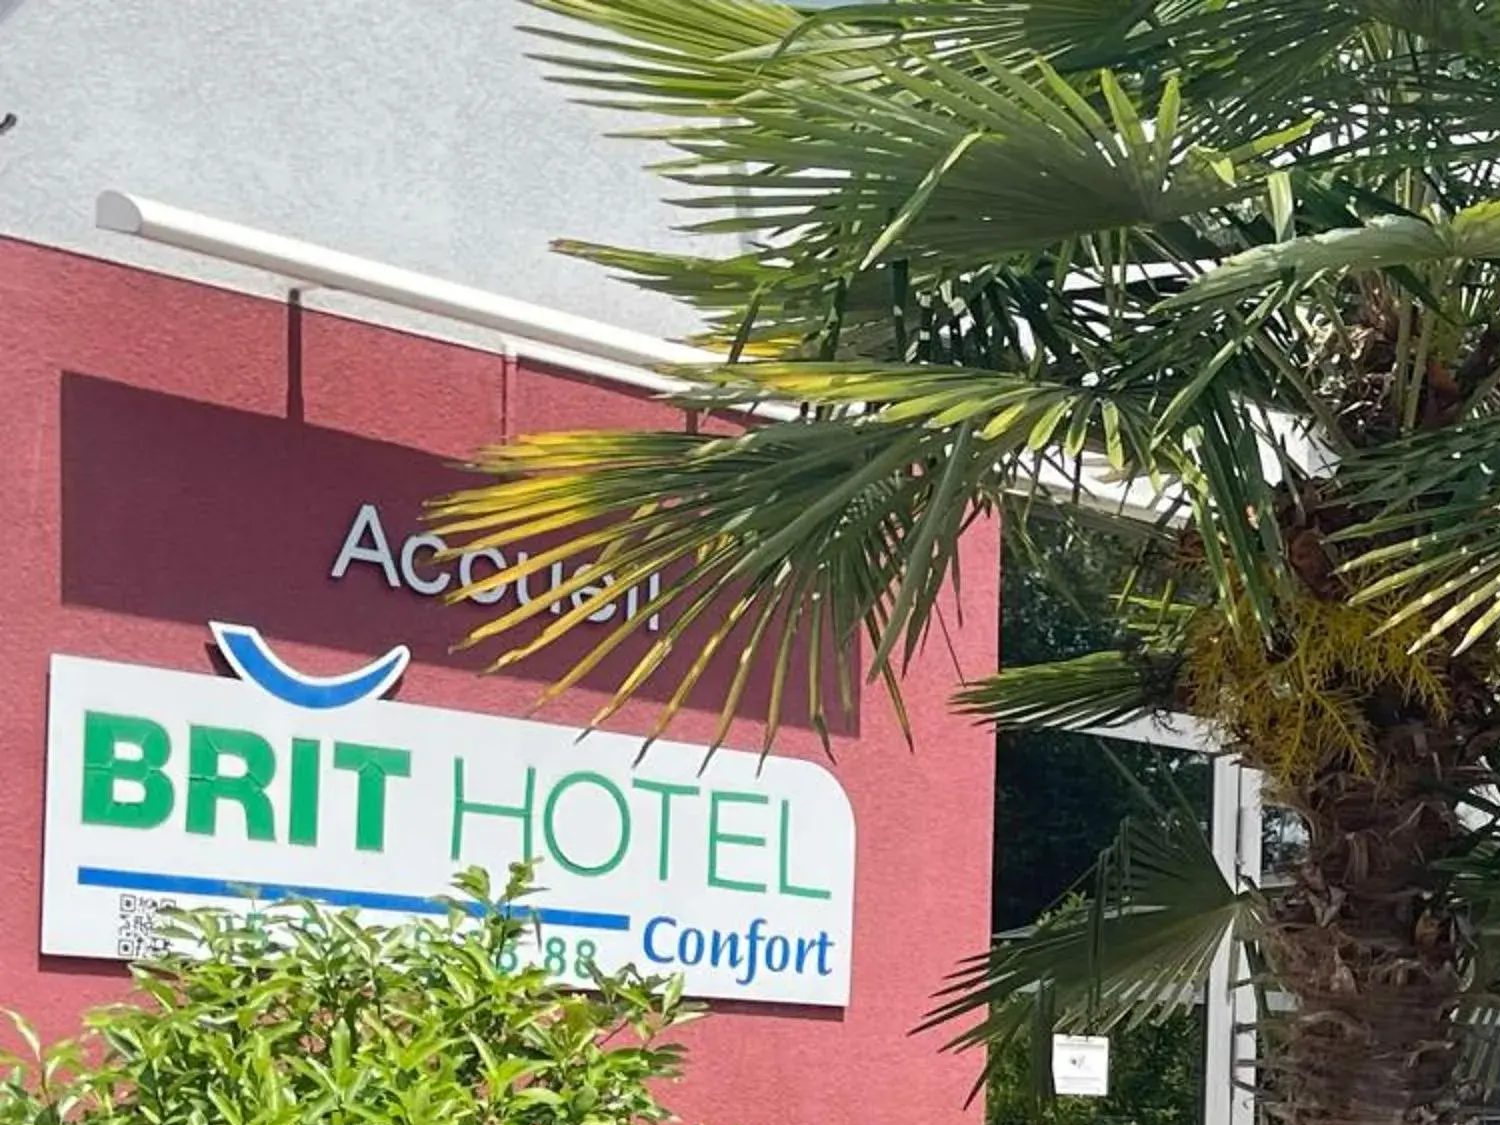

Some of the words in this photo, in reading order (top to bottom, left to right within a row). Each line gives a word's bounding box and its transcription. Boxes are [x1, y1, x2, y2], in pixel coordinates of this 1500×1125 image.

[81, 710, 411, 852] BRIT
[451, 756, 832, 900] HOTEL
[643, 916, 836, 985] Confort
